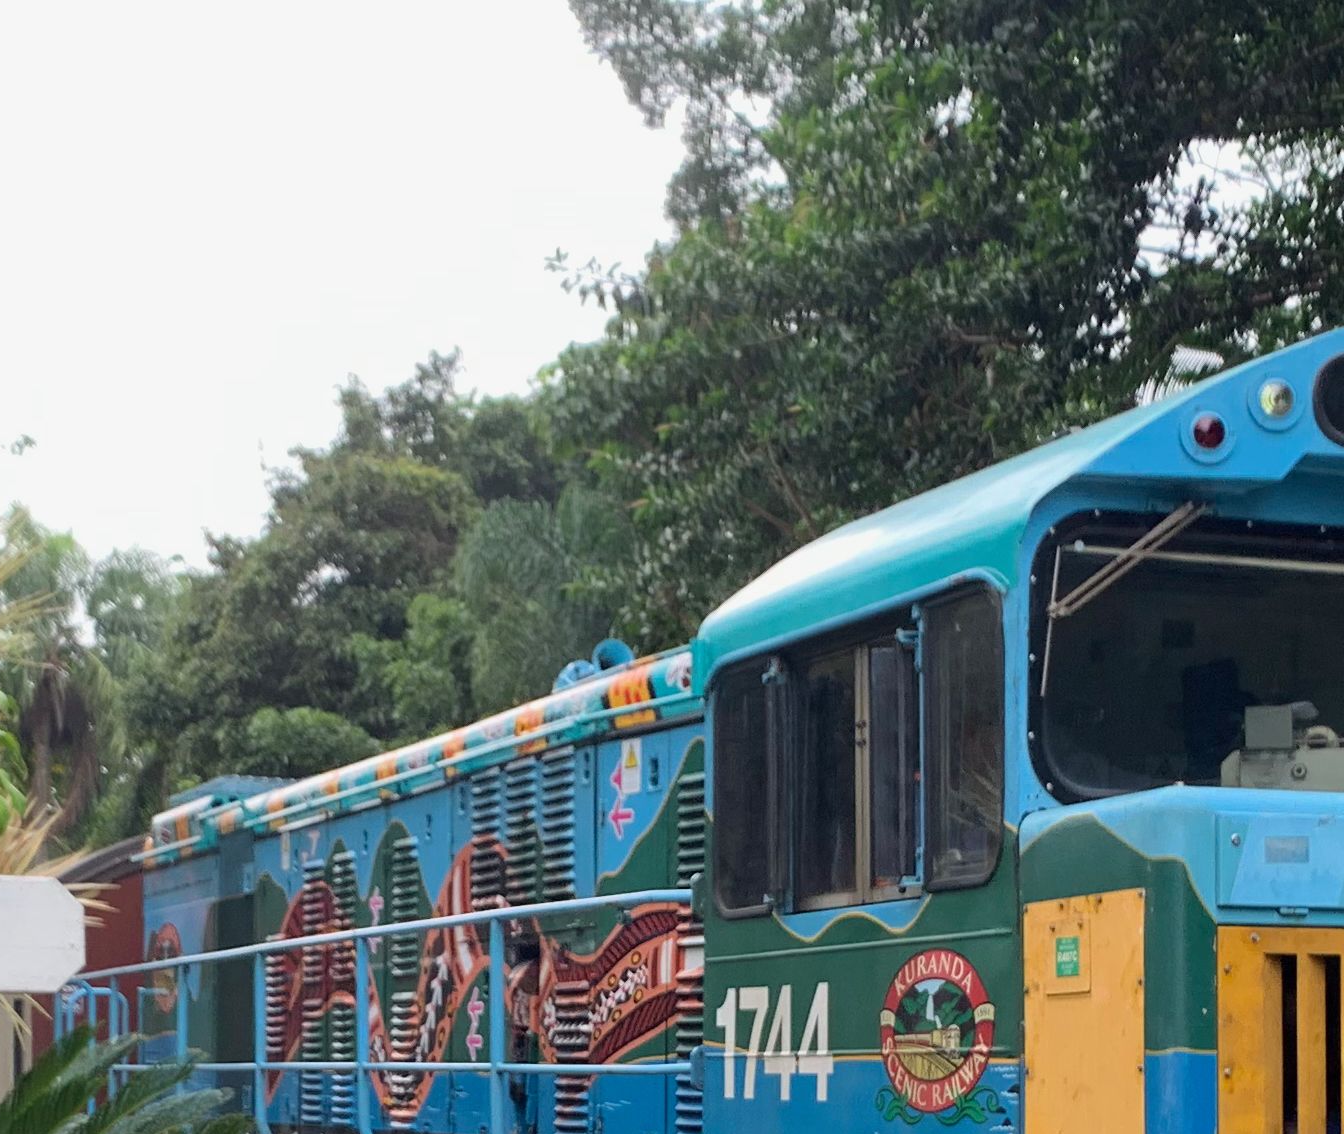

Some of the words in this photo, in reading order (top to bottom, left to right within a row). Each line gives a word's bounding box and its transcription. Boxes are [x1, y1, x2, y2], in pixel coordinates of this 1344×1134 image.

[895, 952, 973, 996] KURANDA
[716, 982, 834, 1102] 1744
[882, 1037, 927, 1106] SCENIC
[932, 1033, 989, 1106] RAILWAY
